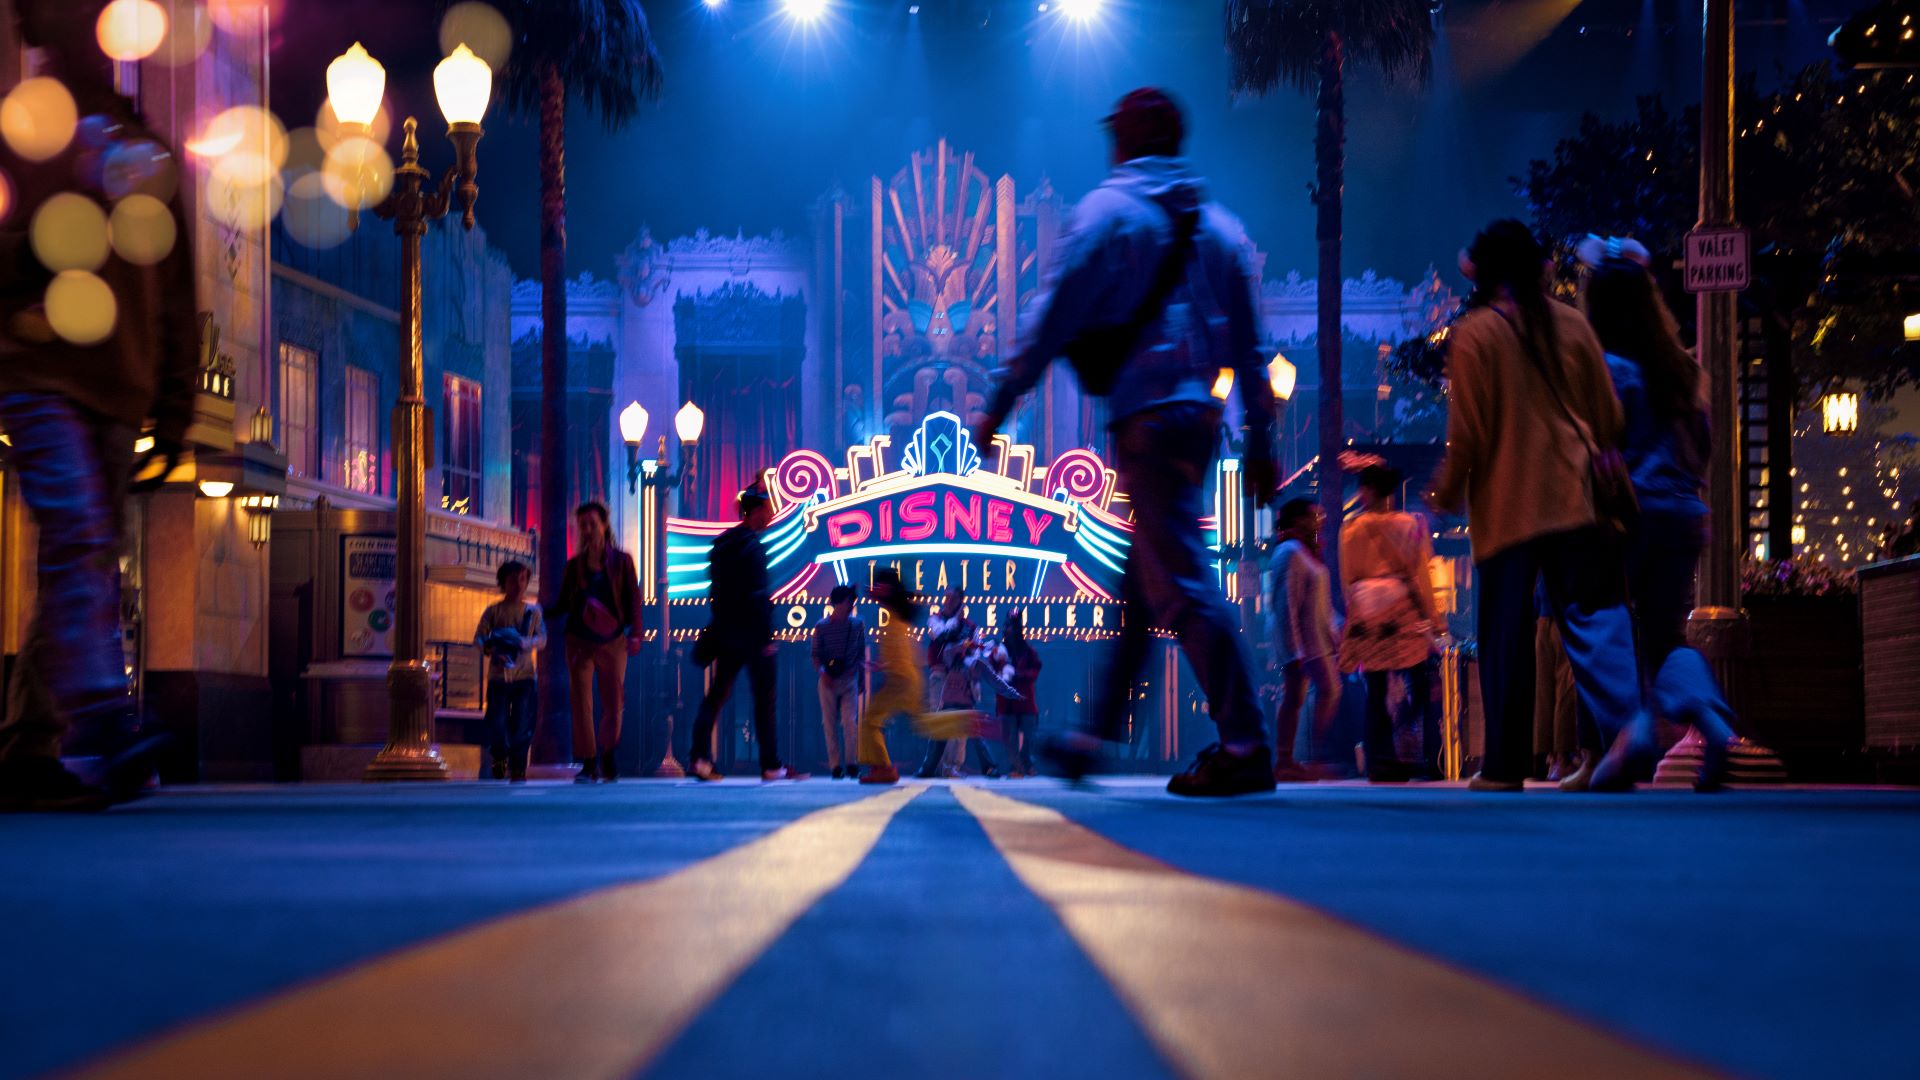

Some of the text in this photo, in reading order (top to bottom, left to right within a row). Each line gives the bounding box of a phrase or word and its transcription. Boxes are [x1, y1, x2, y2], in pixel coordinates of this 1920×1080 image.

[1698, 237, 1735, 256] VALET
[1690, 261, 1744, 284] PARKING
[827, 491, 1053, 547] DISNEY
